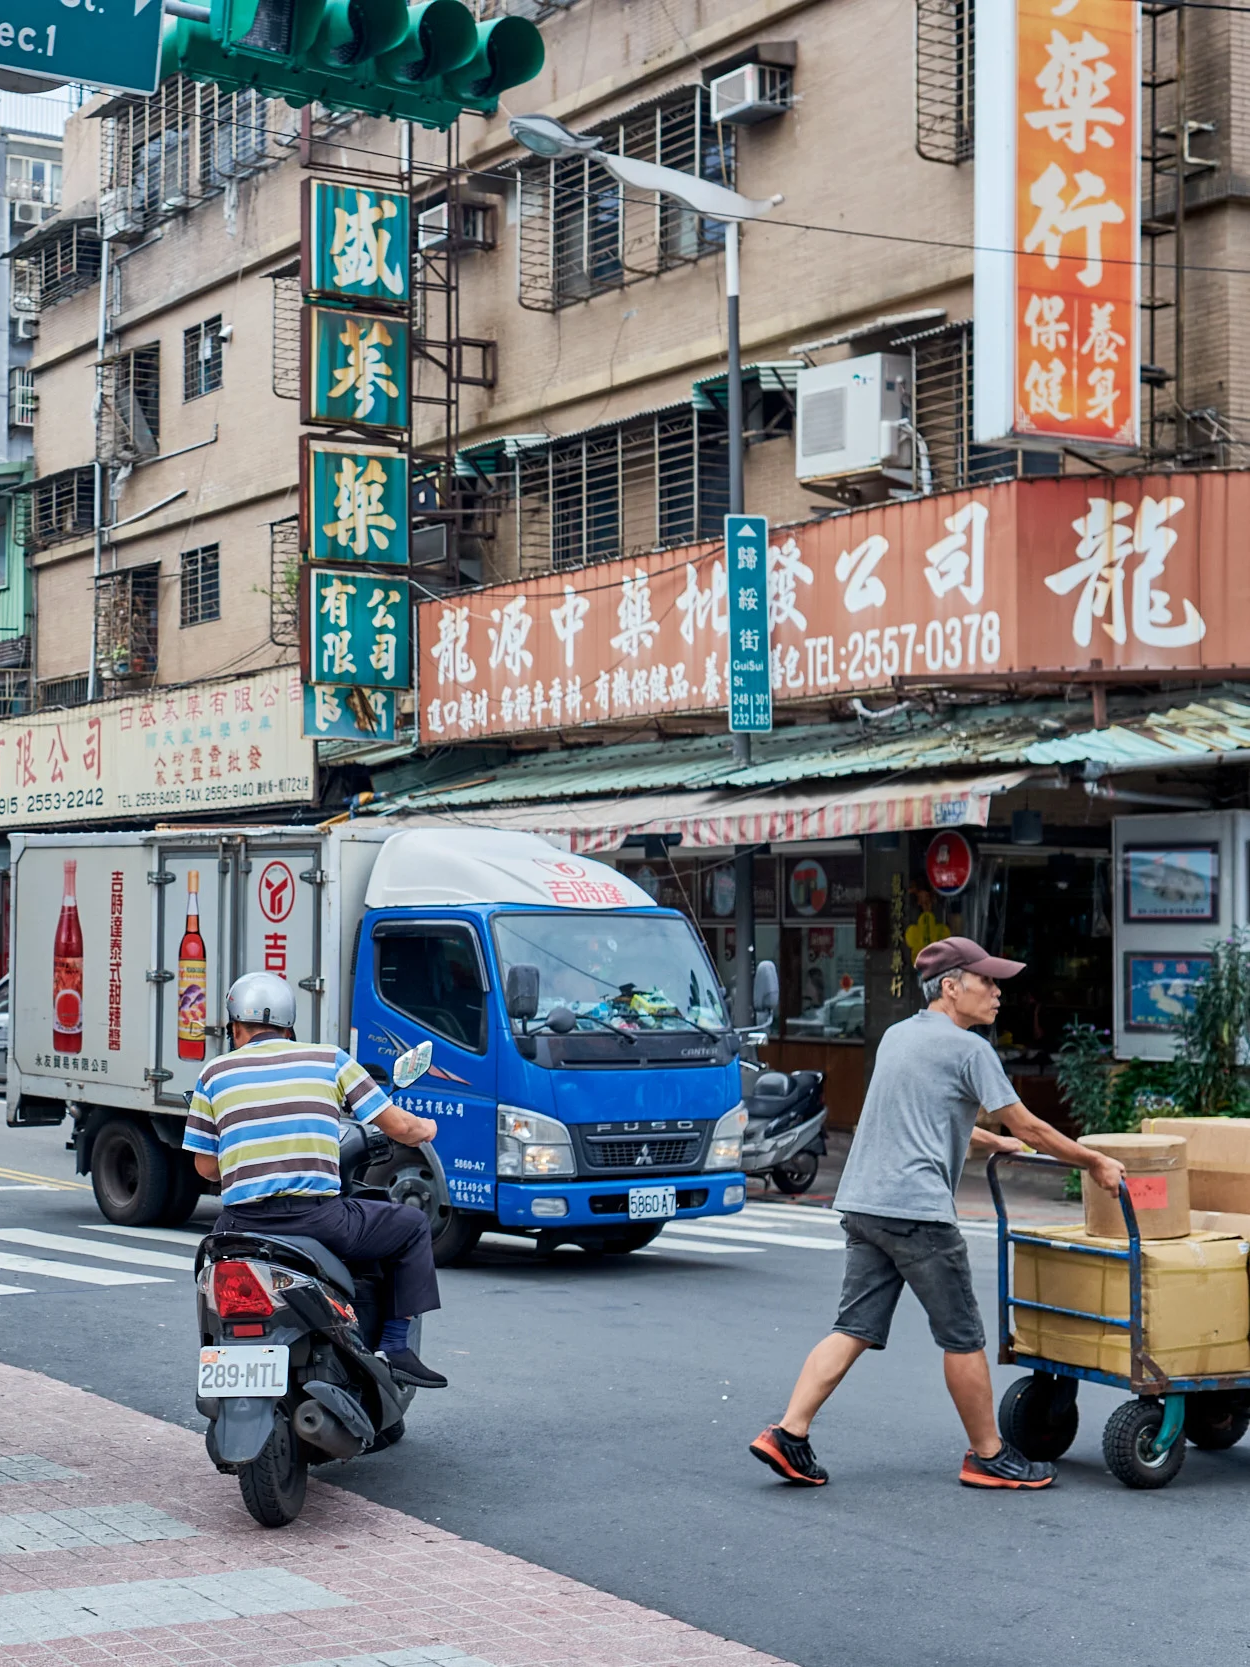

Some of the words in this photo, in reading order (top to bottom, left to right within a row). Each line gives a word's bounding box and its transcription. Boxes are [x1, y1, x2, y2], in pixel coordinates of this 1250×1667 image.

[1023, 0, 1126, 287] 藥行
[1023, 294, 1073, 422] 保健
[1080, 302, 1127, 428] 養身
[1043, 495, 1206, 648] 龍
[737, 546, 760, 653] 歸綏街
[320, 578, 357, 675] 有限
[366, 588, 401, 681] 公司
[733, 660, 763, 671] GuiSui
[733, 693, 749, 705] 248
[734, 713, 750, 725] 232
[26, 787, 104, 813] 2553-2242
[543, 880, 627, 905] 吉時達
[680, 1047, 719, 1057] CANTER
[597, 1120, 694, 1132] FUSO
[201, 1363, 284, 1389] 289-MTL
